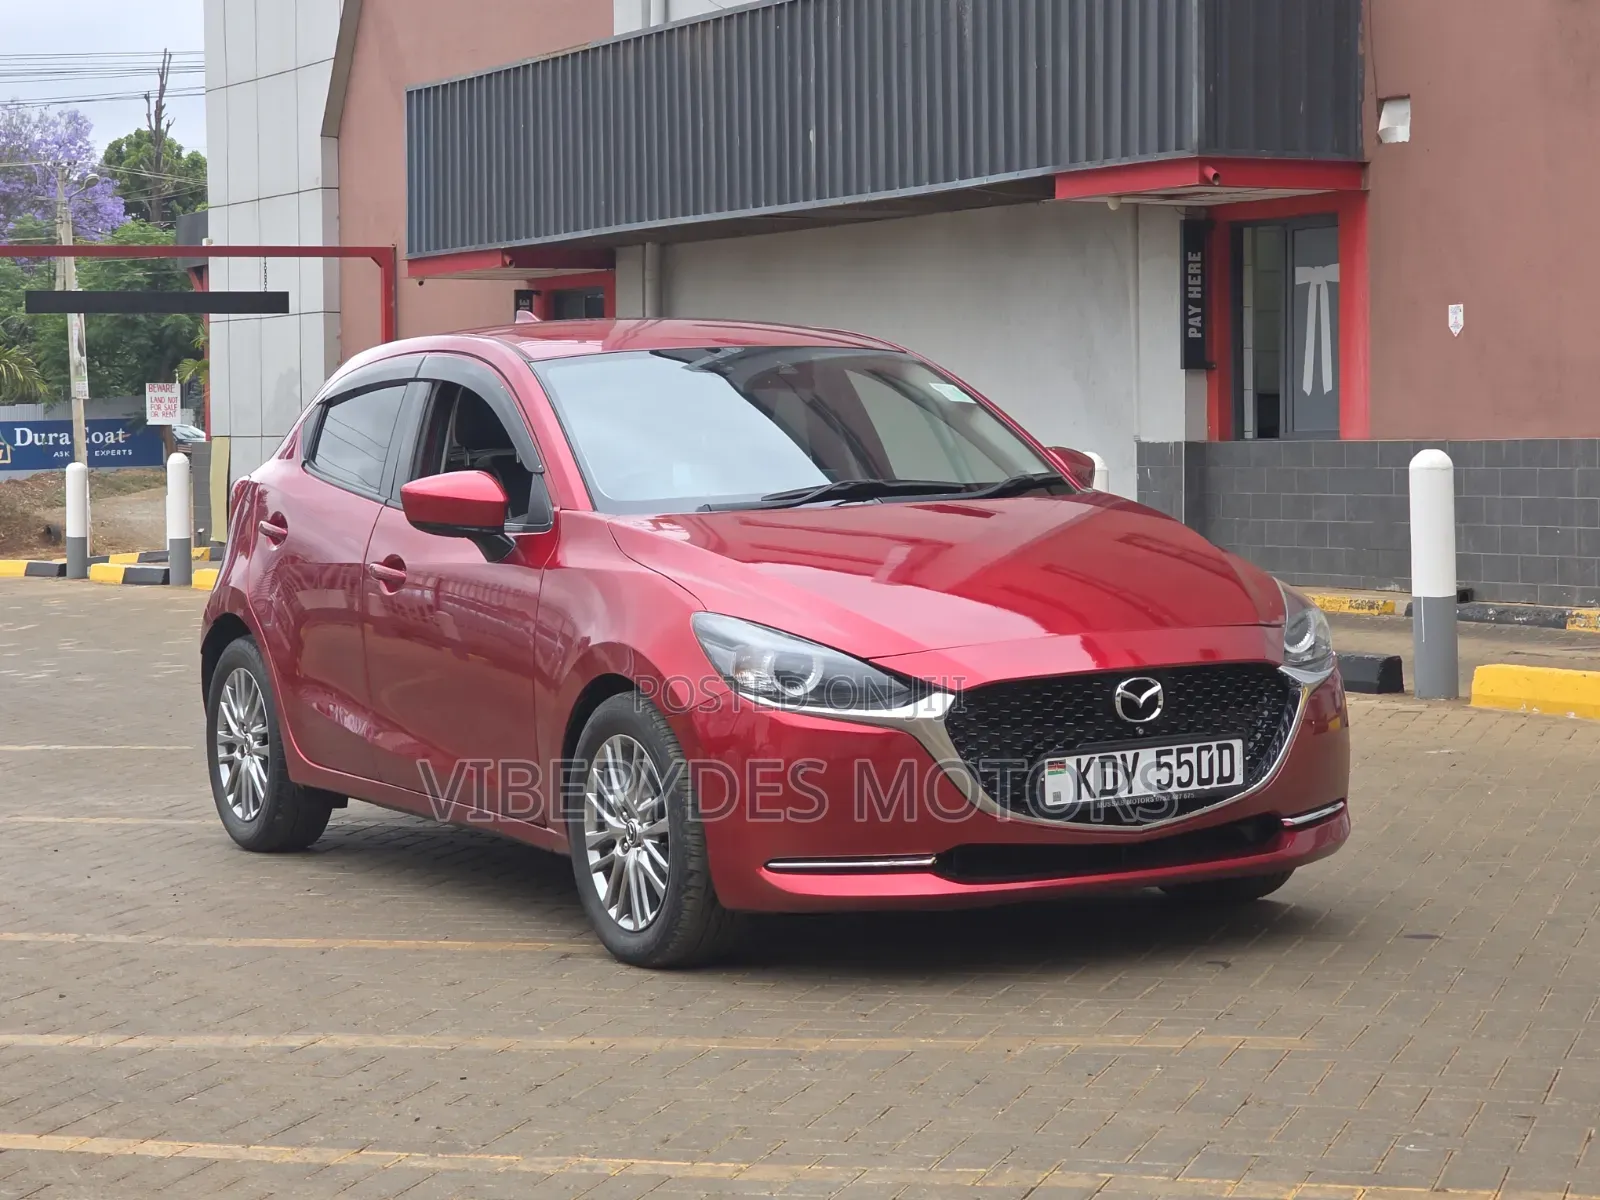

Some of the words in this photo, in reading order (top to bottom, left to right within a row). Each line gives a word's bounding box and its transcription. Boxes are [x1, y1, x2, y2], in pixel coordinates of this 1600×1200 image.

[1188, 251, 1202, 299] HERE
[1188, 304, 1202, 338] PAY
[148, 383, 176, 393] BEWARE
[150, 396, 166, 404] LAND
[167, 396, 179, 404] NOT
[150, 403, 162, 411] FOR
[164, 403, 178, 411] SALE
[150, 410, 160, 418] OR
[161, 410, 177, 418] RENT
[53, 450, 71, 458] ASK
[94, 448, 133, 457] EXPERTS
[1076, 751, 1140, 801] KDY
[1155, 742, 1235, 789] 550D
[1127, 796, 1155, 805] MOTORS
